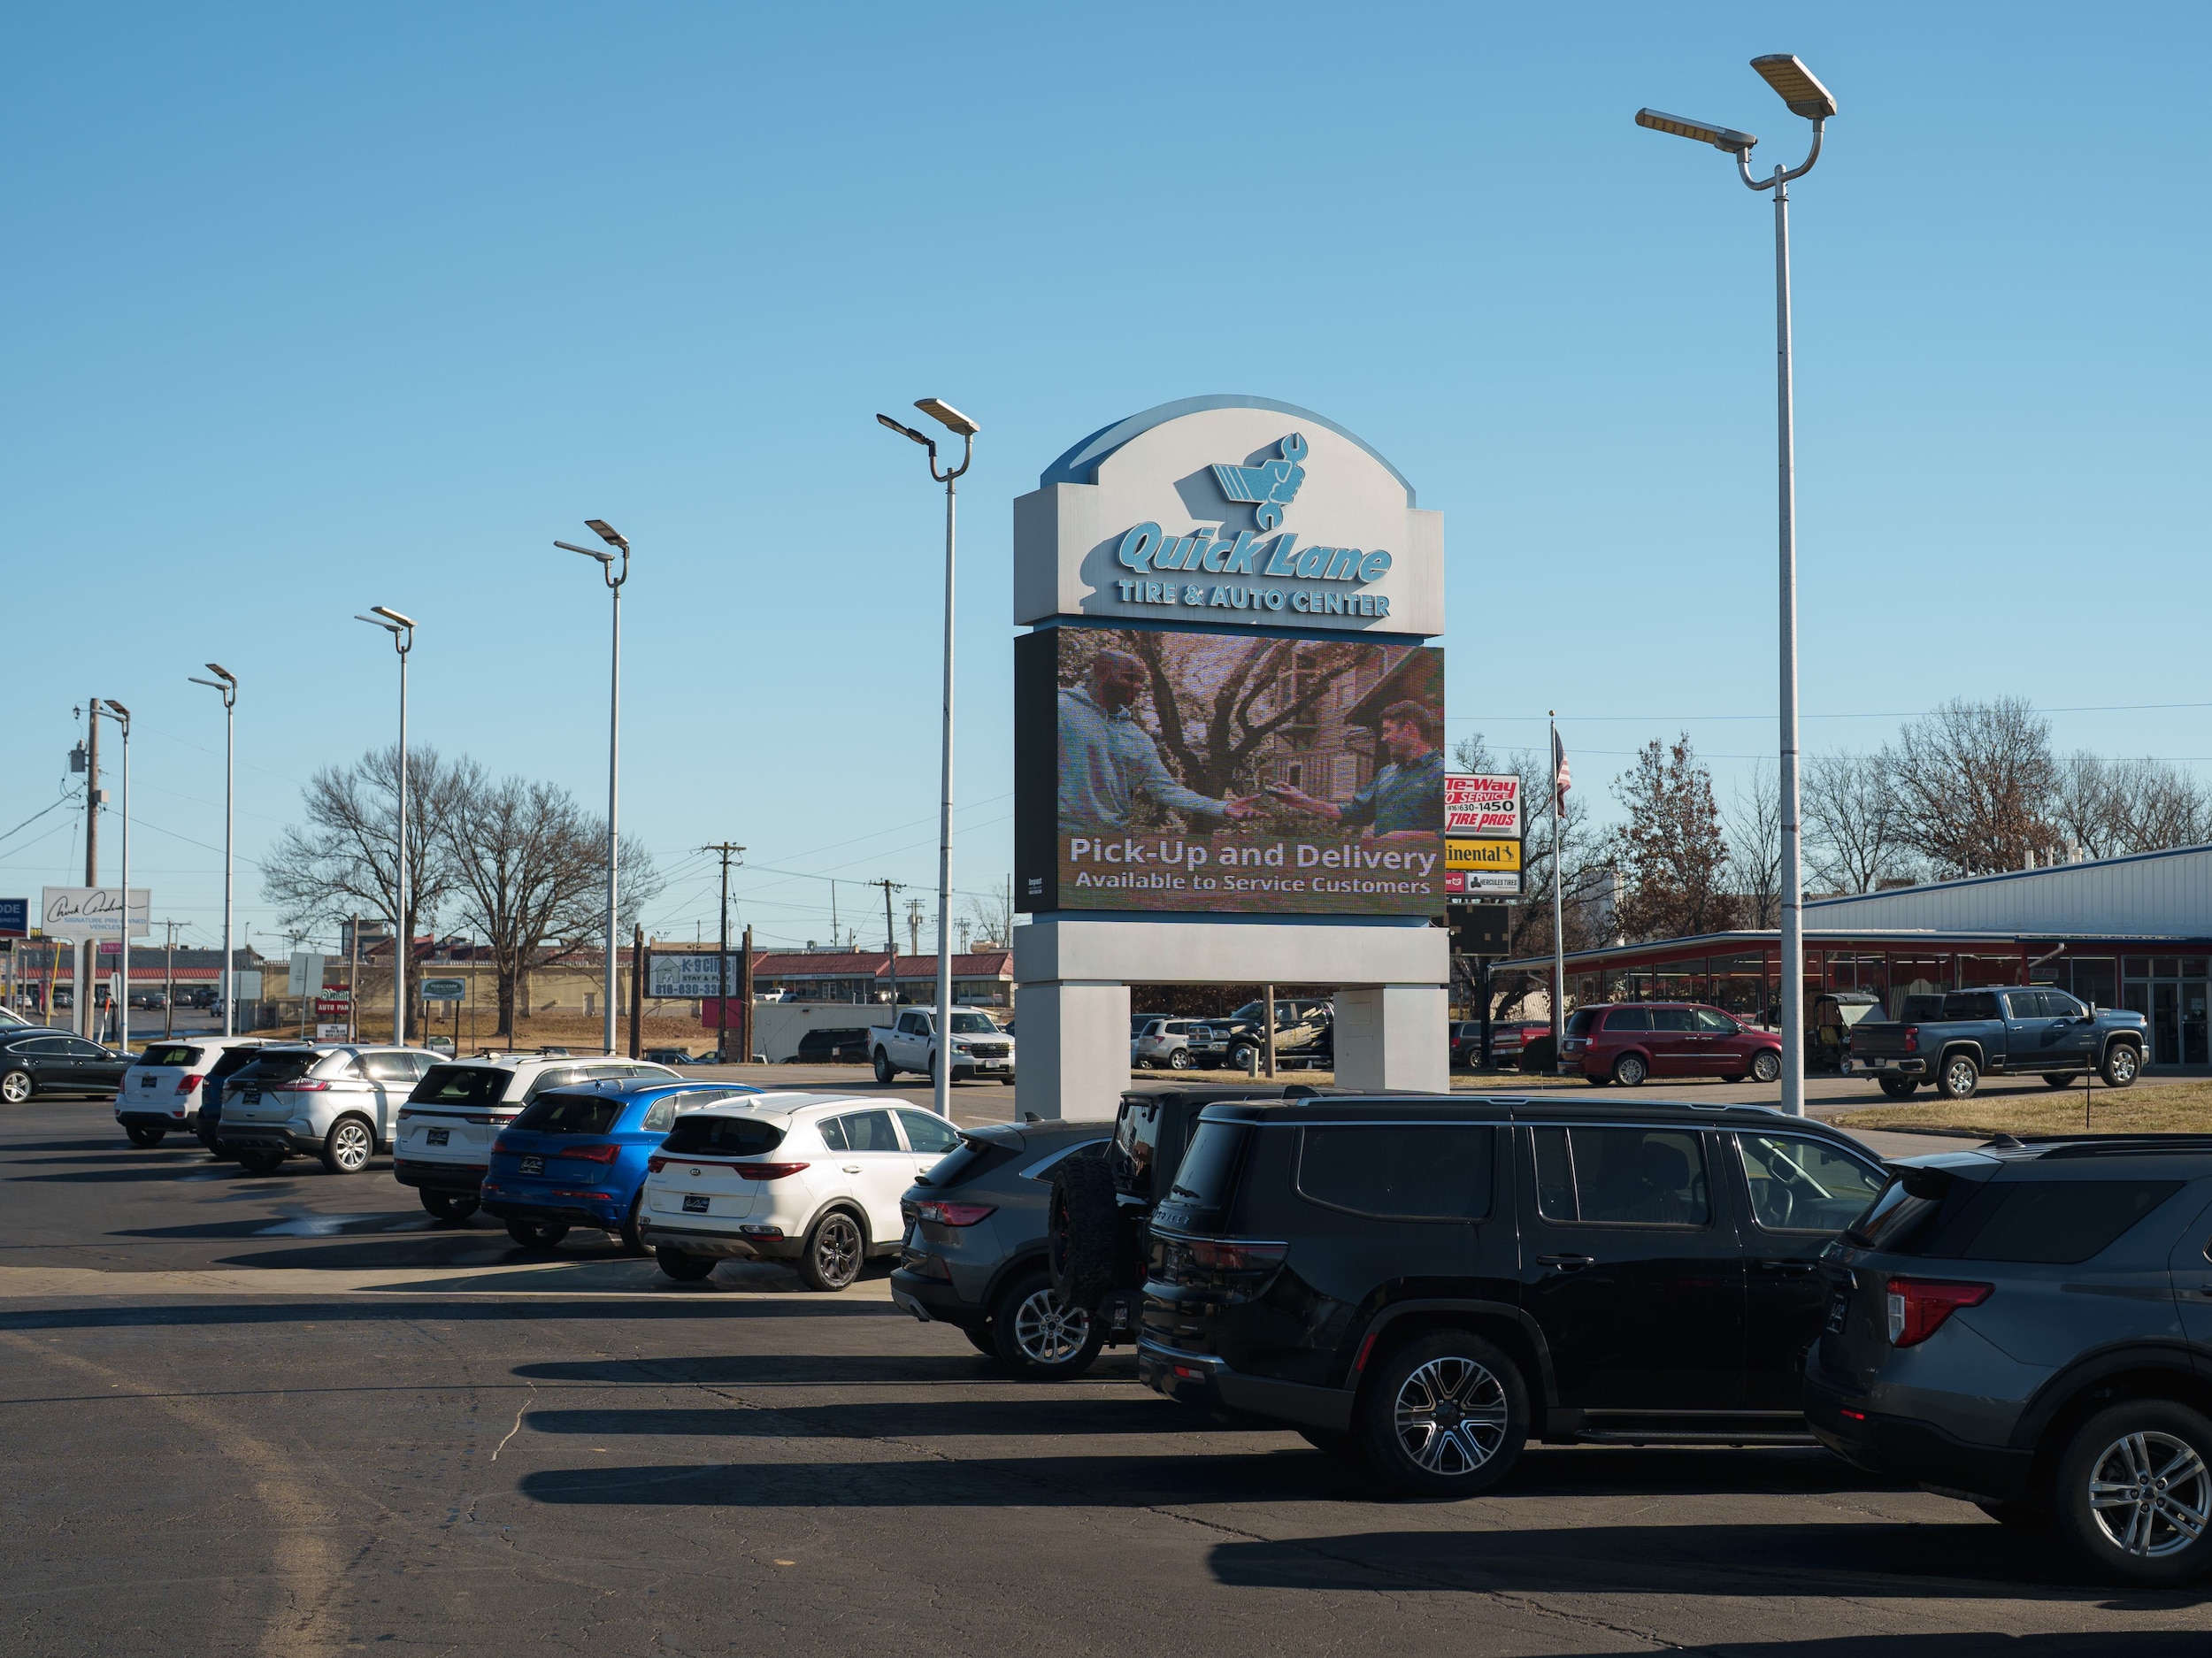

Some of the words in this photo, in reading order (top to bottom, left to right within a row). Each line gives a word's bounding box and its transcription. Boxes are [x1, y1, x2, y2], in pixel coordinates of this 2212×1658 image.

[1118, 520, 1268, 574] Quick
[1264, 533, 1393, 584] Lane
[1117, 579, 1177, 604] TIRE
[1184, 583, 1205, 606] &
[1210, 585, 1286, 610] AUTO
[1293, 590, 1392, 617] CENTER
[1446, 800, 1515, 811] (816)630-1450
[1459, 792, 1510, 802] SERVICE
[1445, 812, 1479, 832] TIRE
[1476, 813, 1516, 833] PROS
[1071, 837, 1208, 871] Pick-Up
[1218, 842, 1284, 867] and
[1297, 844, 1437, 877] Delivery
[1445, 844, 1502, 862] inental
[1075, 871, 1186, 890] Available
[1193, 873, 1216, 891] to
[1223, 874, 1305, 893] Service
[1312, 876, 1432, 894] Customers
[47, 895, 80, 923] Chuck
[682, 958, 702, 973] K-9
